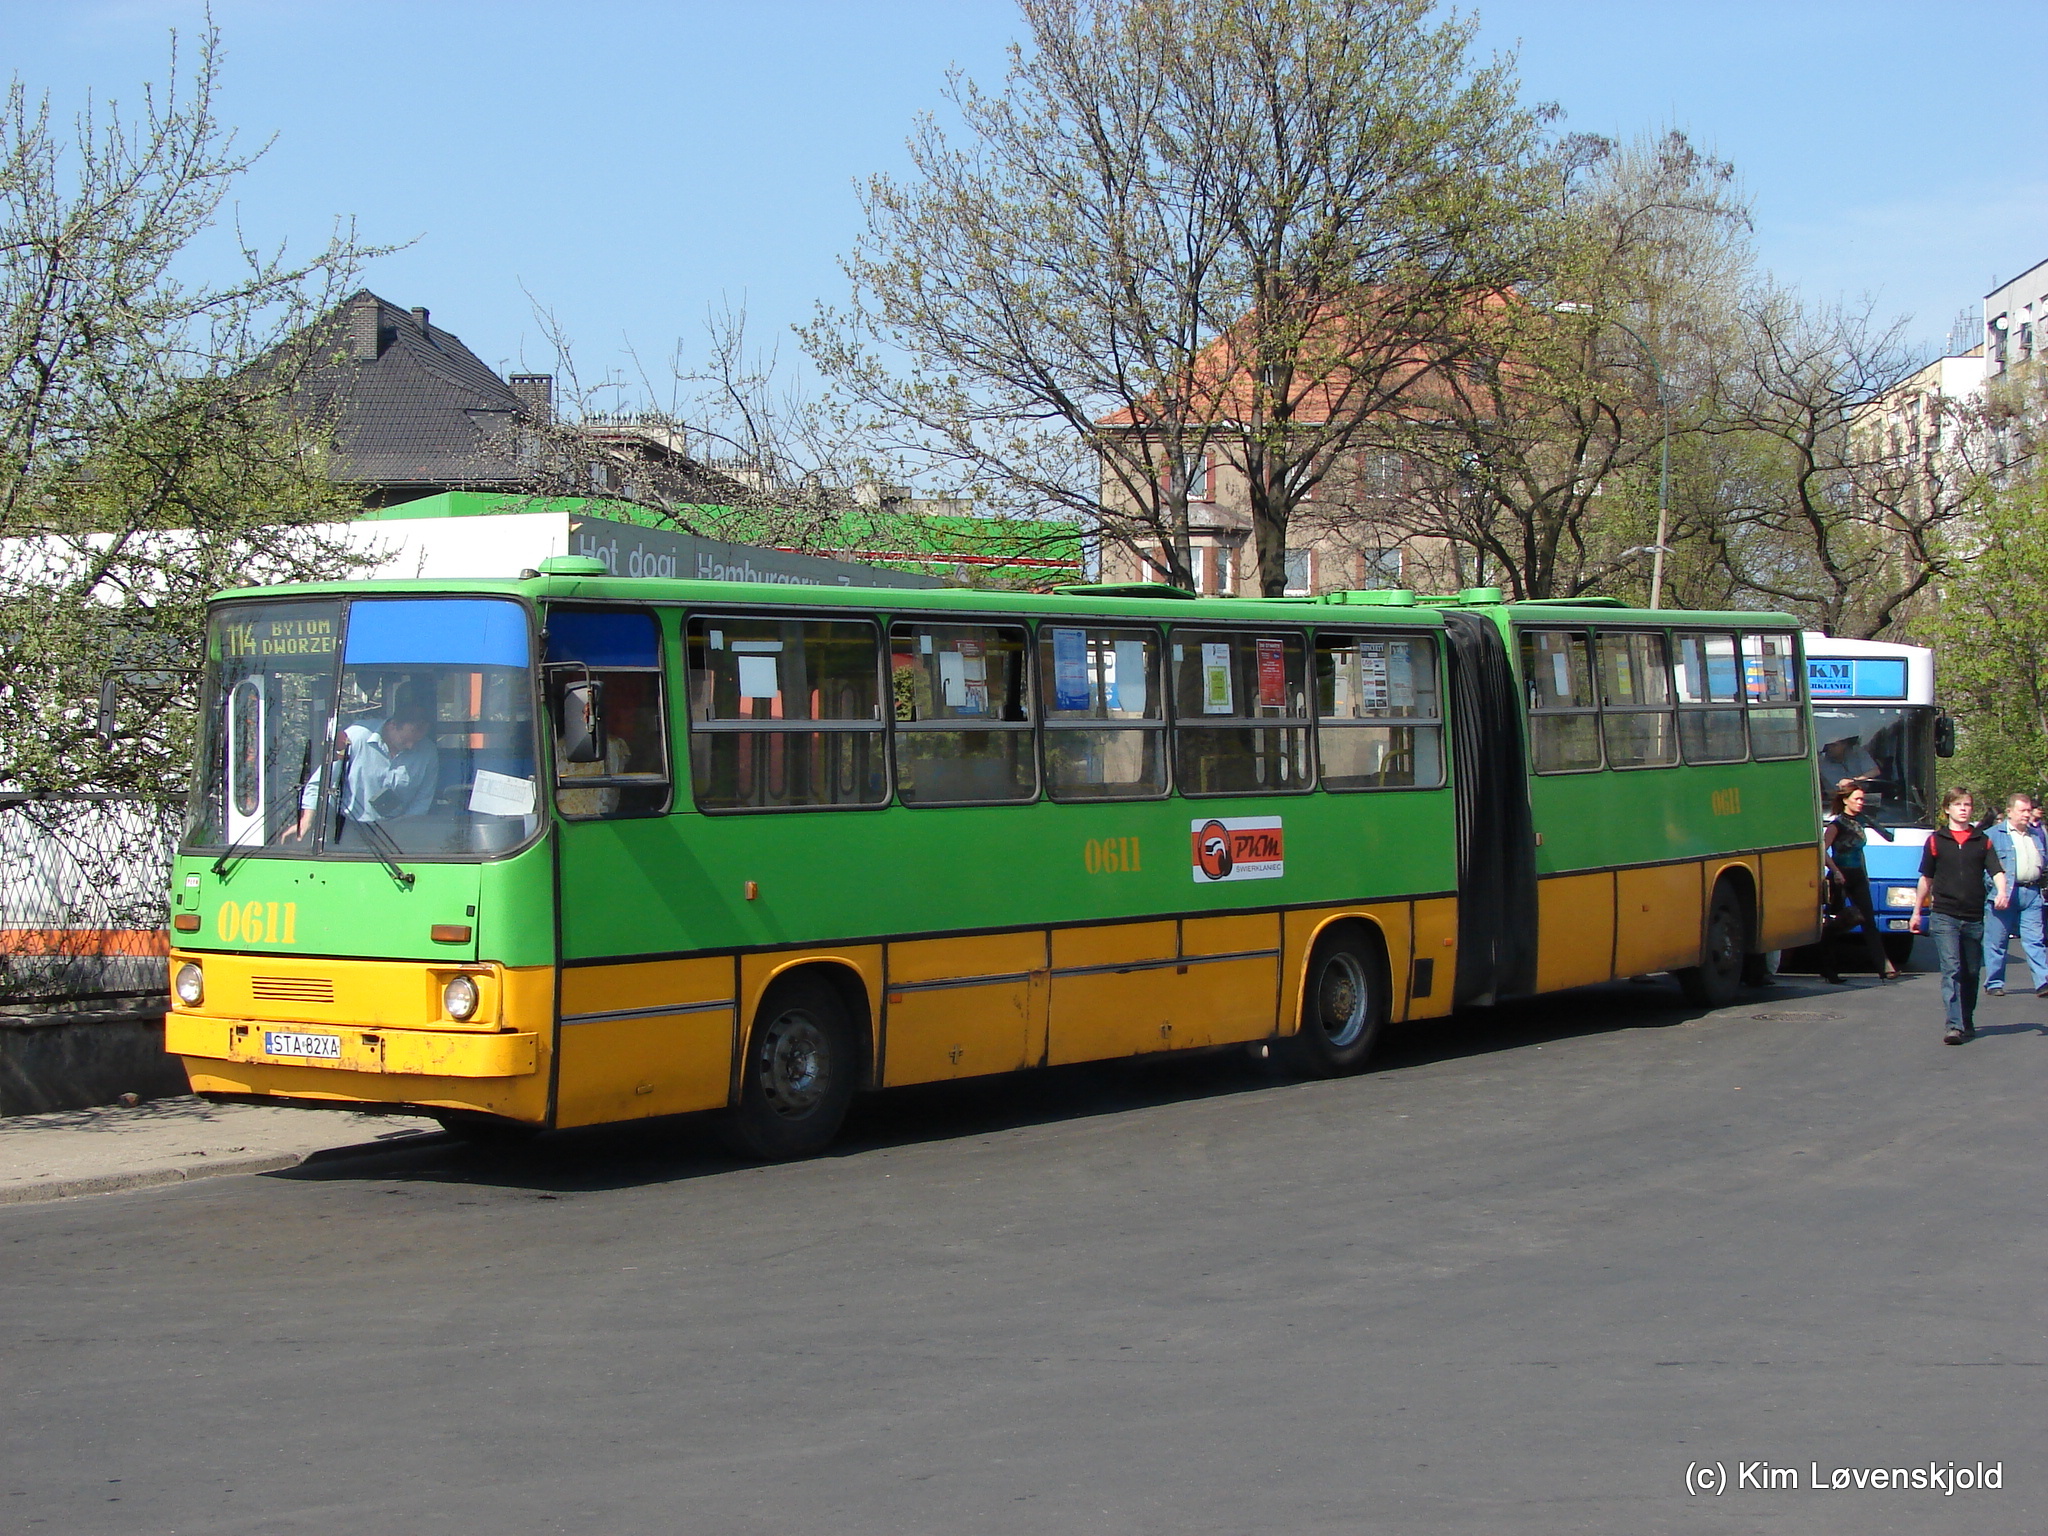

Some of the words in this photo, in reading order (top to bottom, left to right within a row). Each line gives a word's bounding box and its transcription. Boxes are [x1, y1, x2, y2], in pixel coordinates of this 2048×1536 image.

[580, 534, 619, 576] Hot
[226, 623, 257, 656] 114
[271, 620, 331, 636] BYTOM
[1806, 664, 1850, 678] KM
[1084, 837, 1142, 874] 0611
[1234, 835, 1280, 858] PKM
[217, 901, 297, 944] 0611
[273, 1035, 302, 1053] STA
[306, 1037, 339, 1056] 82XA
